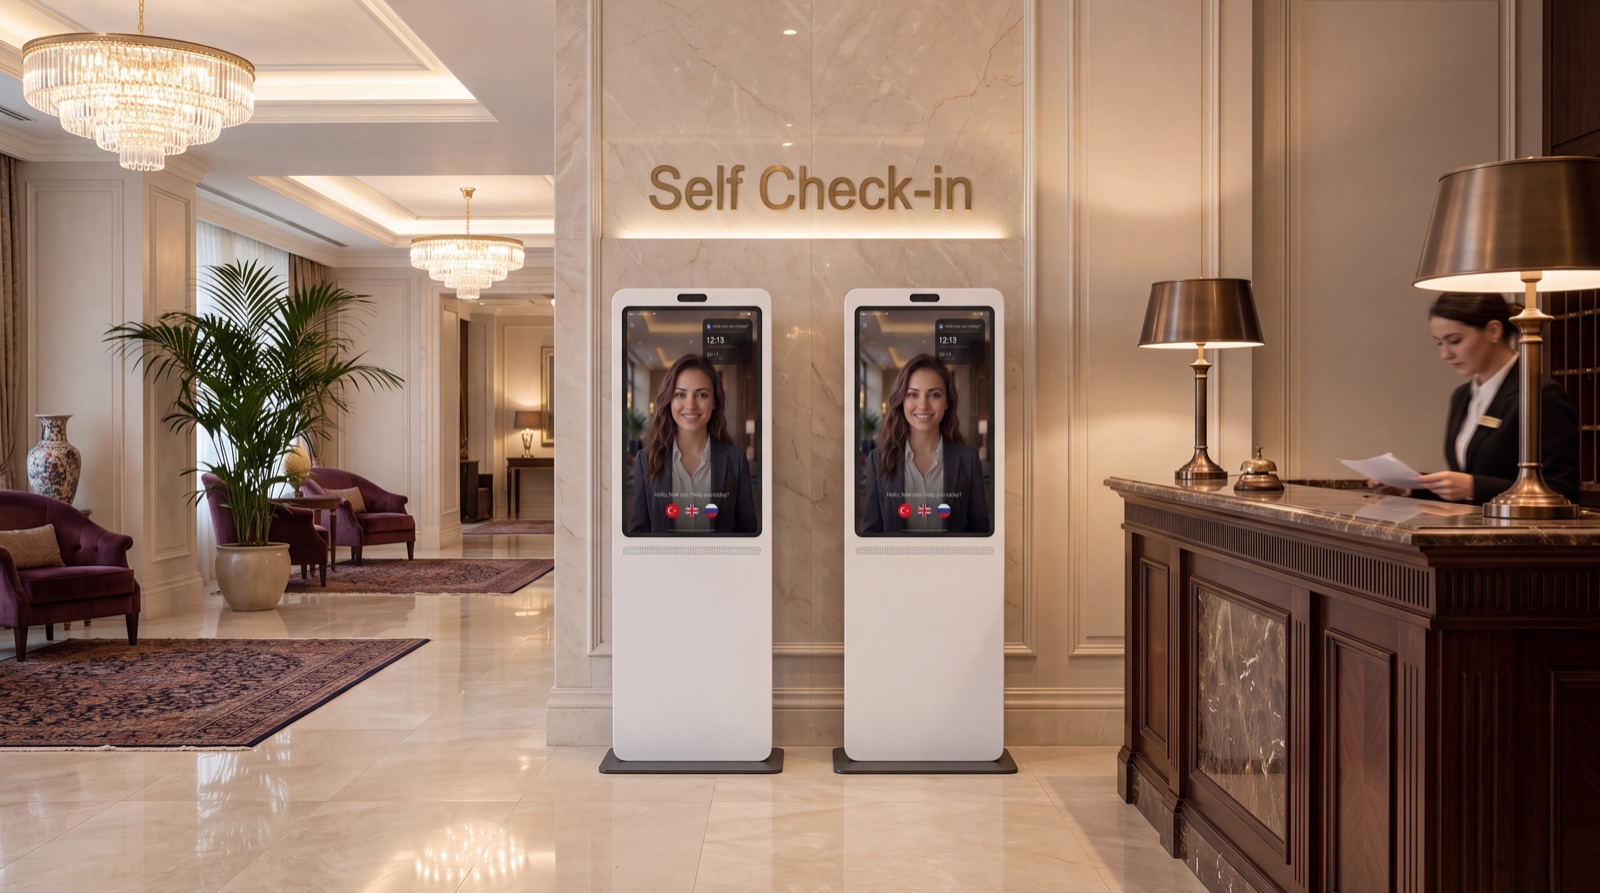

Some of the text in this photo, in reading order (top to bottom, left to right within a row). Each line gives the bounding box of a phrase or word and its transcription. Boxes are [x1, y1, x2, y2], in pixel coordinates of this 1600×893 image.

[649, 164, 973, 211] Self Check-in
[706, 336, 725, 344] 12:13
[938, 336, 958, 344] 12:13
